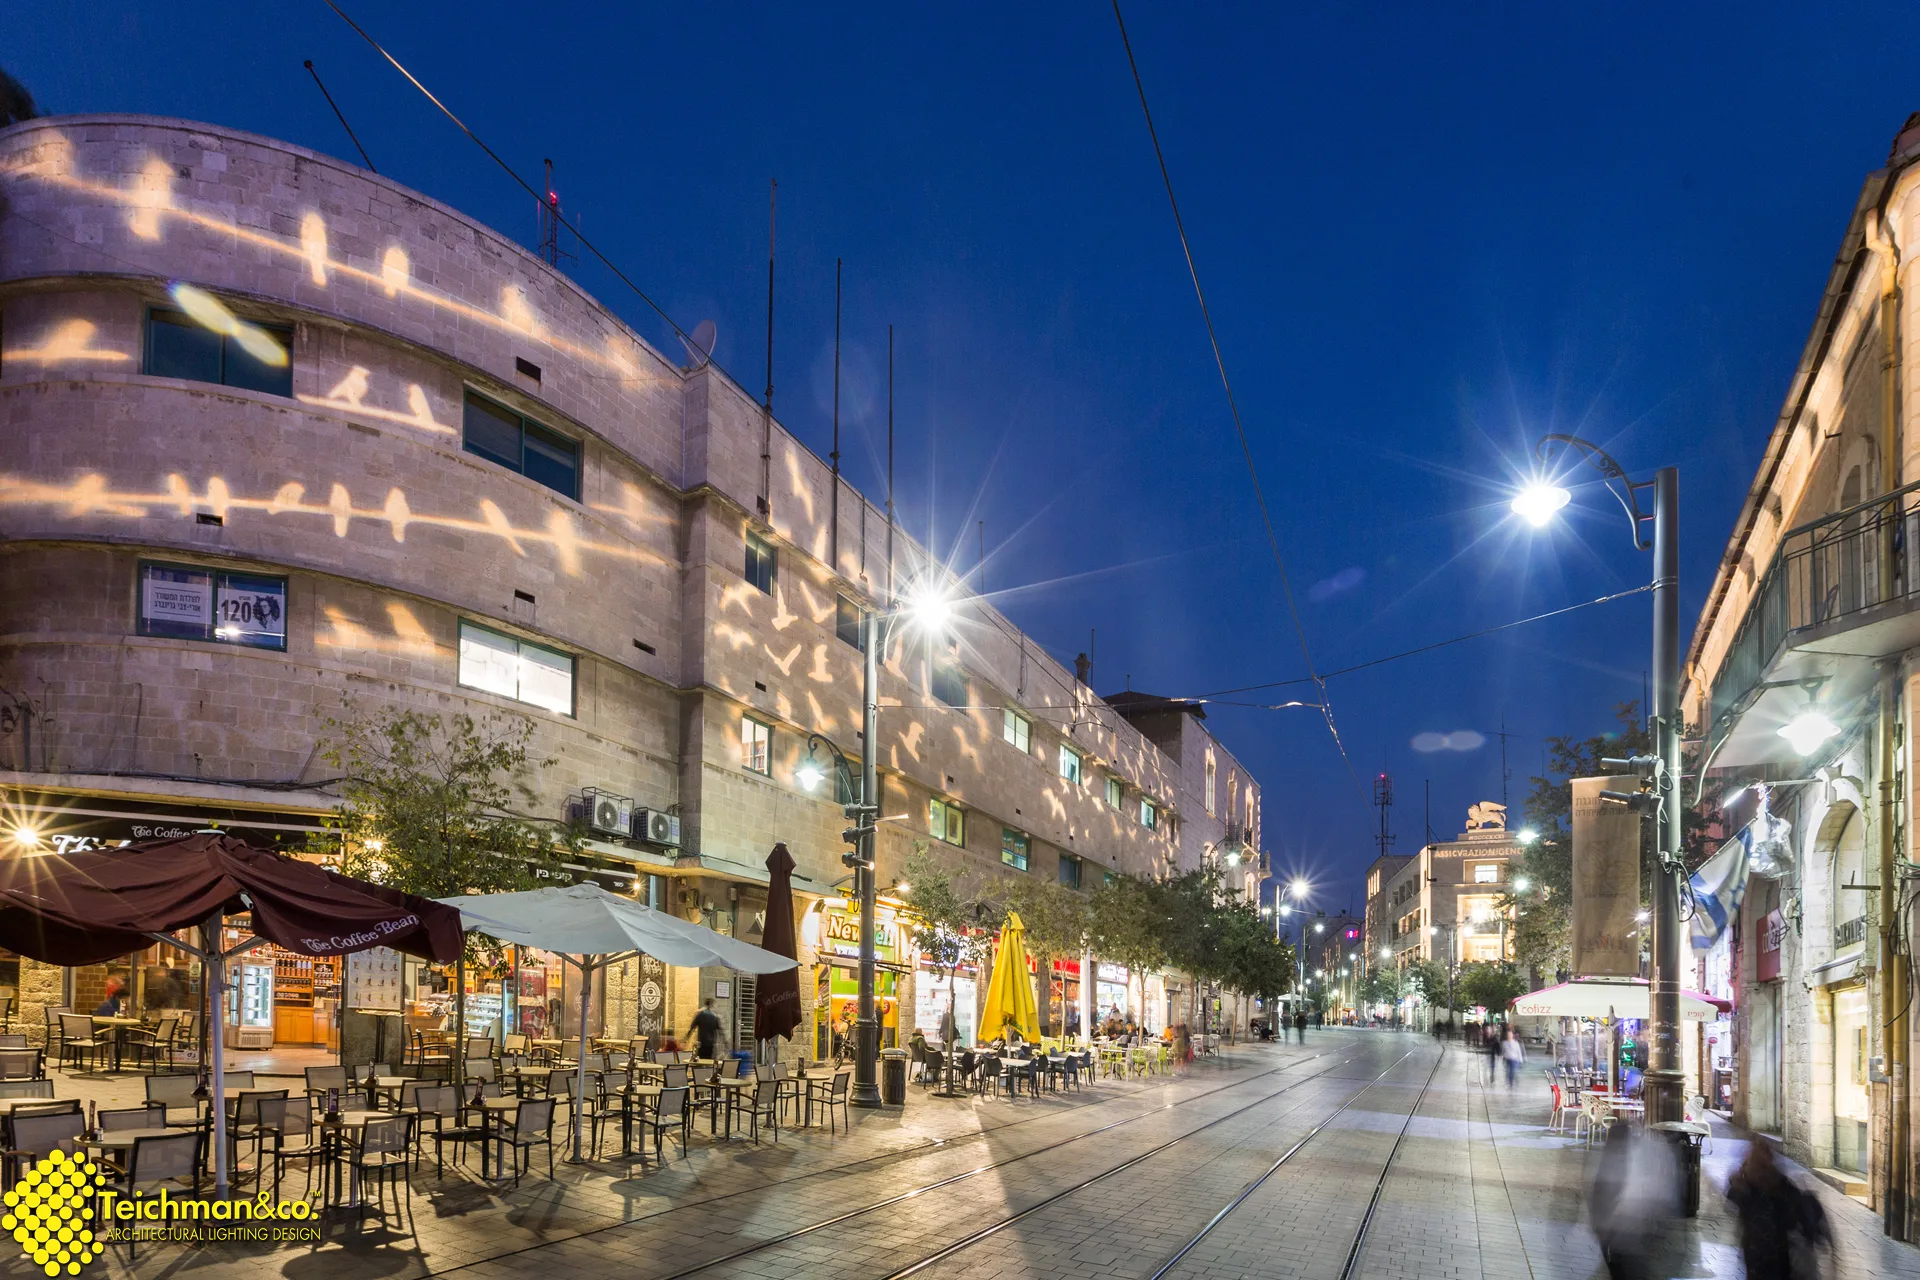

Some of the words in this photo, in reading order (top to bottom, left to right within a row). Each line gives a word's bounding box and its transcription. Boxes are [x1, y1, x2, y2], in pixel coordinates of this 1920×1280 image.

[221, 599, 252, 623] 120
[154, 826, 191, 838] Coffee
[301, 938, 332, 952] The
[330, 931, 379, 949] Coffee
[374, 914, 419, 934] Bean
[1521, 1004, 1551, 1015] cofizz
